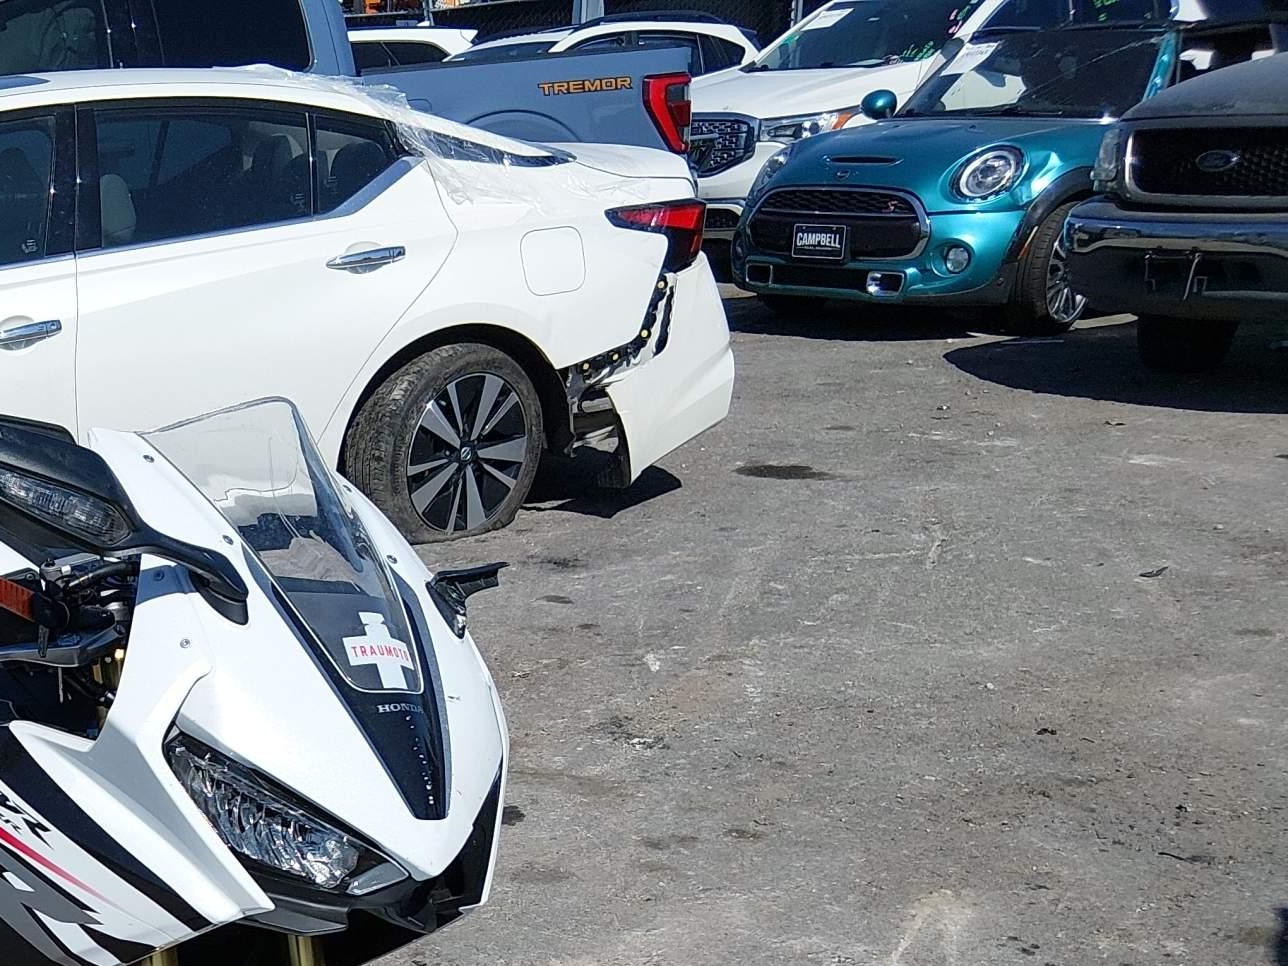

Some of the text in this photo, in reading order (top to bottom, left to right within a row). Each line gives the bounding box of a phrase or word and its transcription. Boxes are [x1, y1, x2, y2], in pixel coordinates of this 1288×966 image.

[537, 76, 633, 96] TREMOR
[796, 232, 841, 248] CAMPBELL
[376, 703, 424, 714] HONDA
